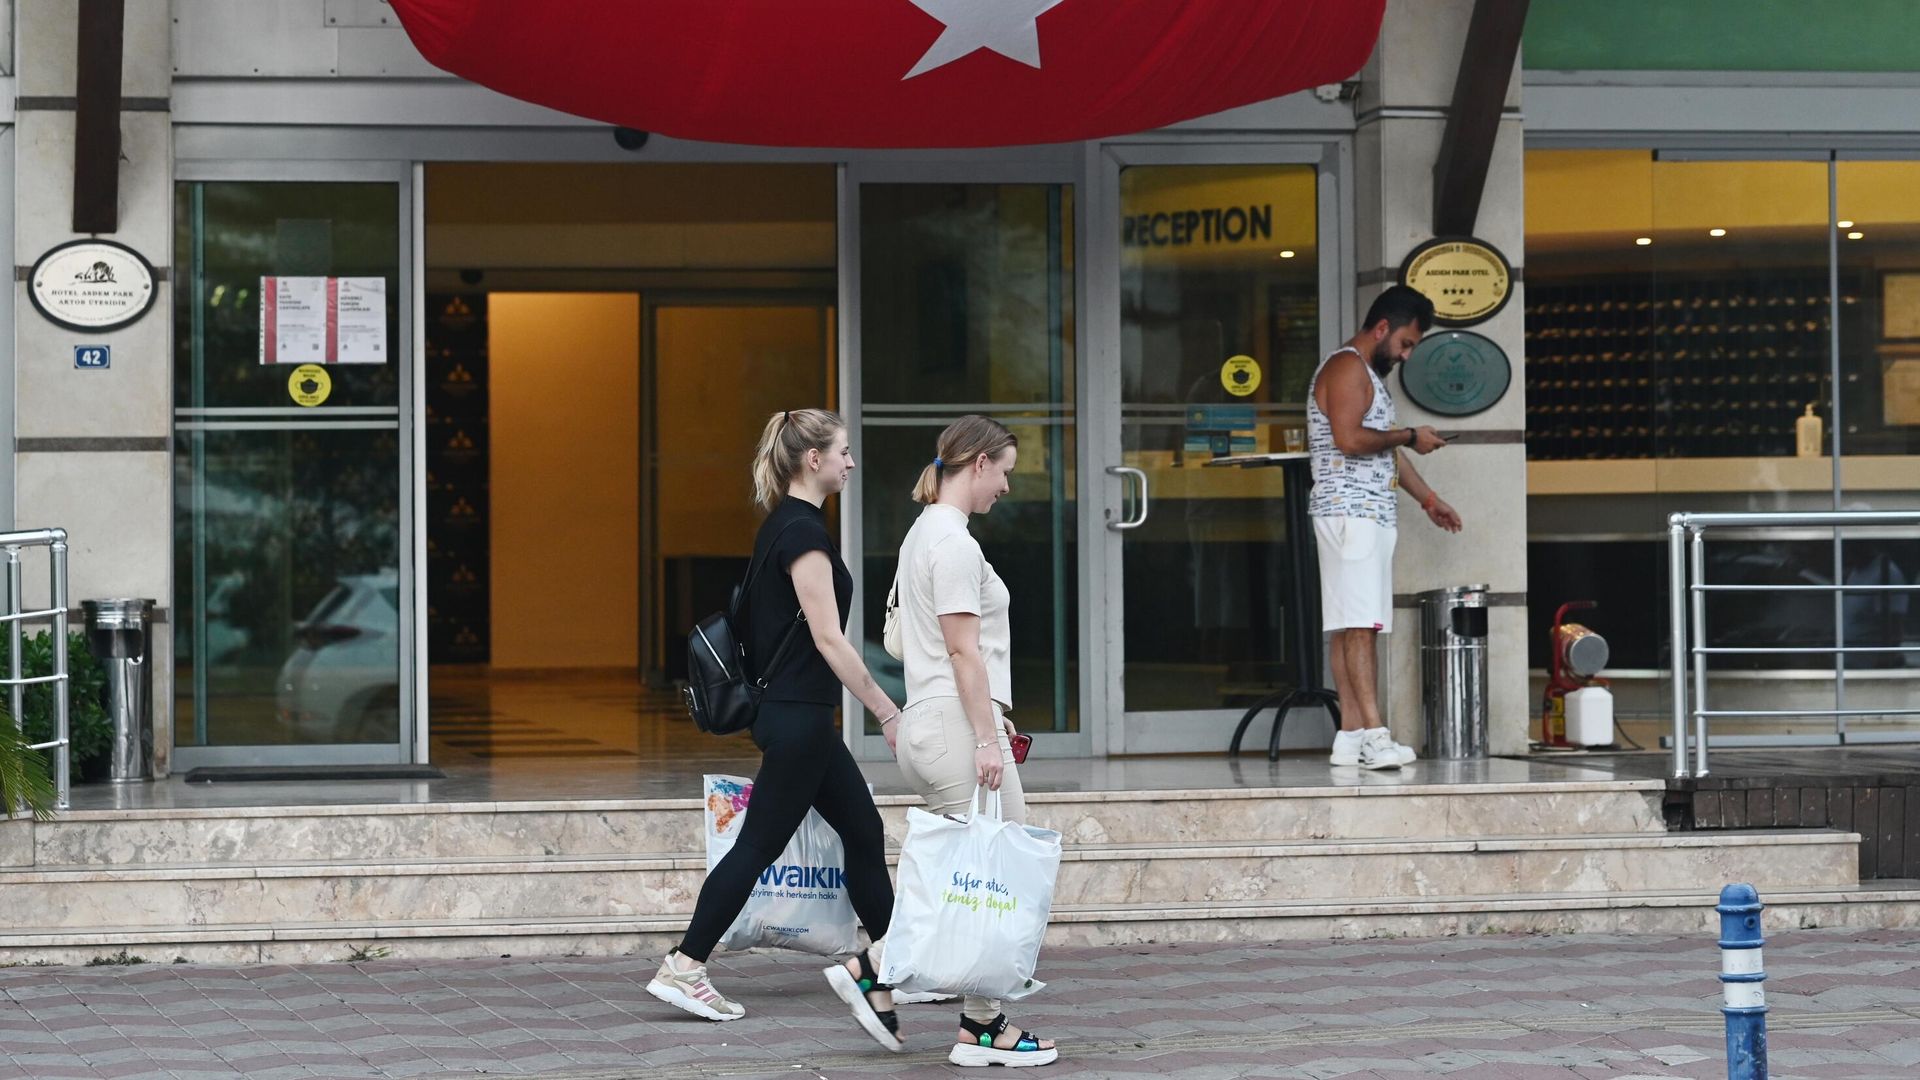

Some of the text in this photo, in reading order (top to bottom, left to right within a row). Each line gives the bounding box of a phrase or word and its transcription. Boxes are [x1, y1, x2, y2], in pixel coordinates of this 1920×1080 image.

[1123, 204, 1272, 247] RECEPTION
[113, 290, 134, 298] PARK
[82, 350, 101, 365] 42
[786, 890, 817, 899] herkesin
[818, 891, 838, 900] hakkı
[762, 925, 810, 934] LCWAIKIKI.COM
